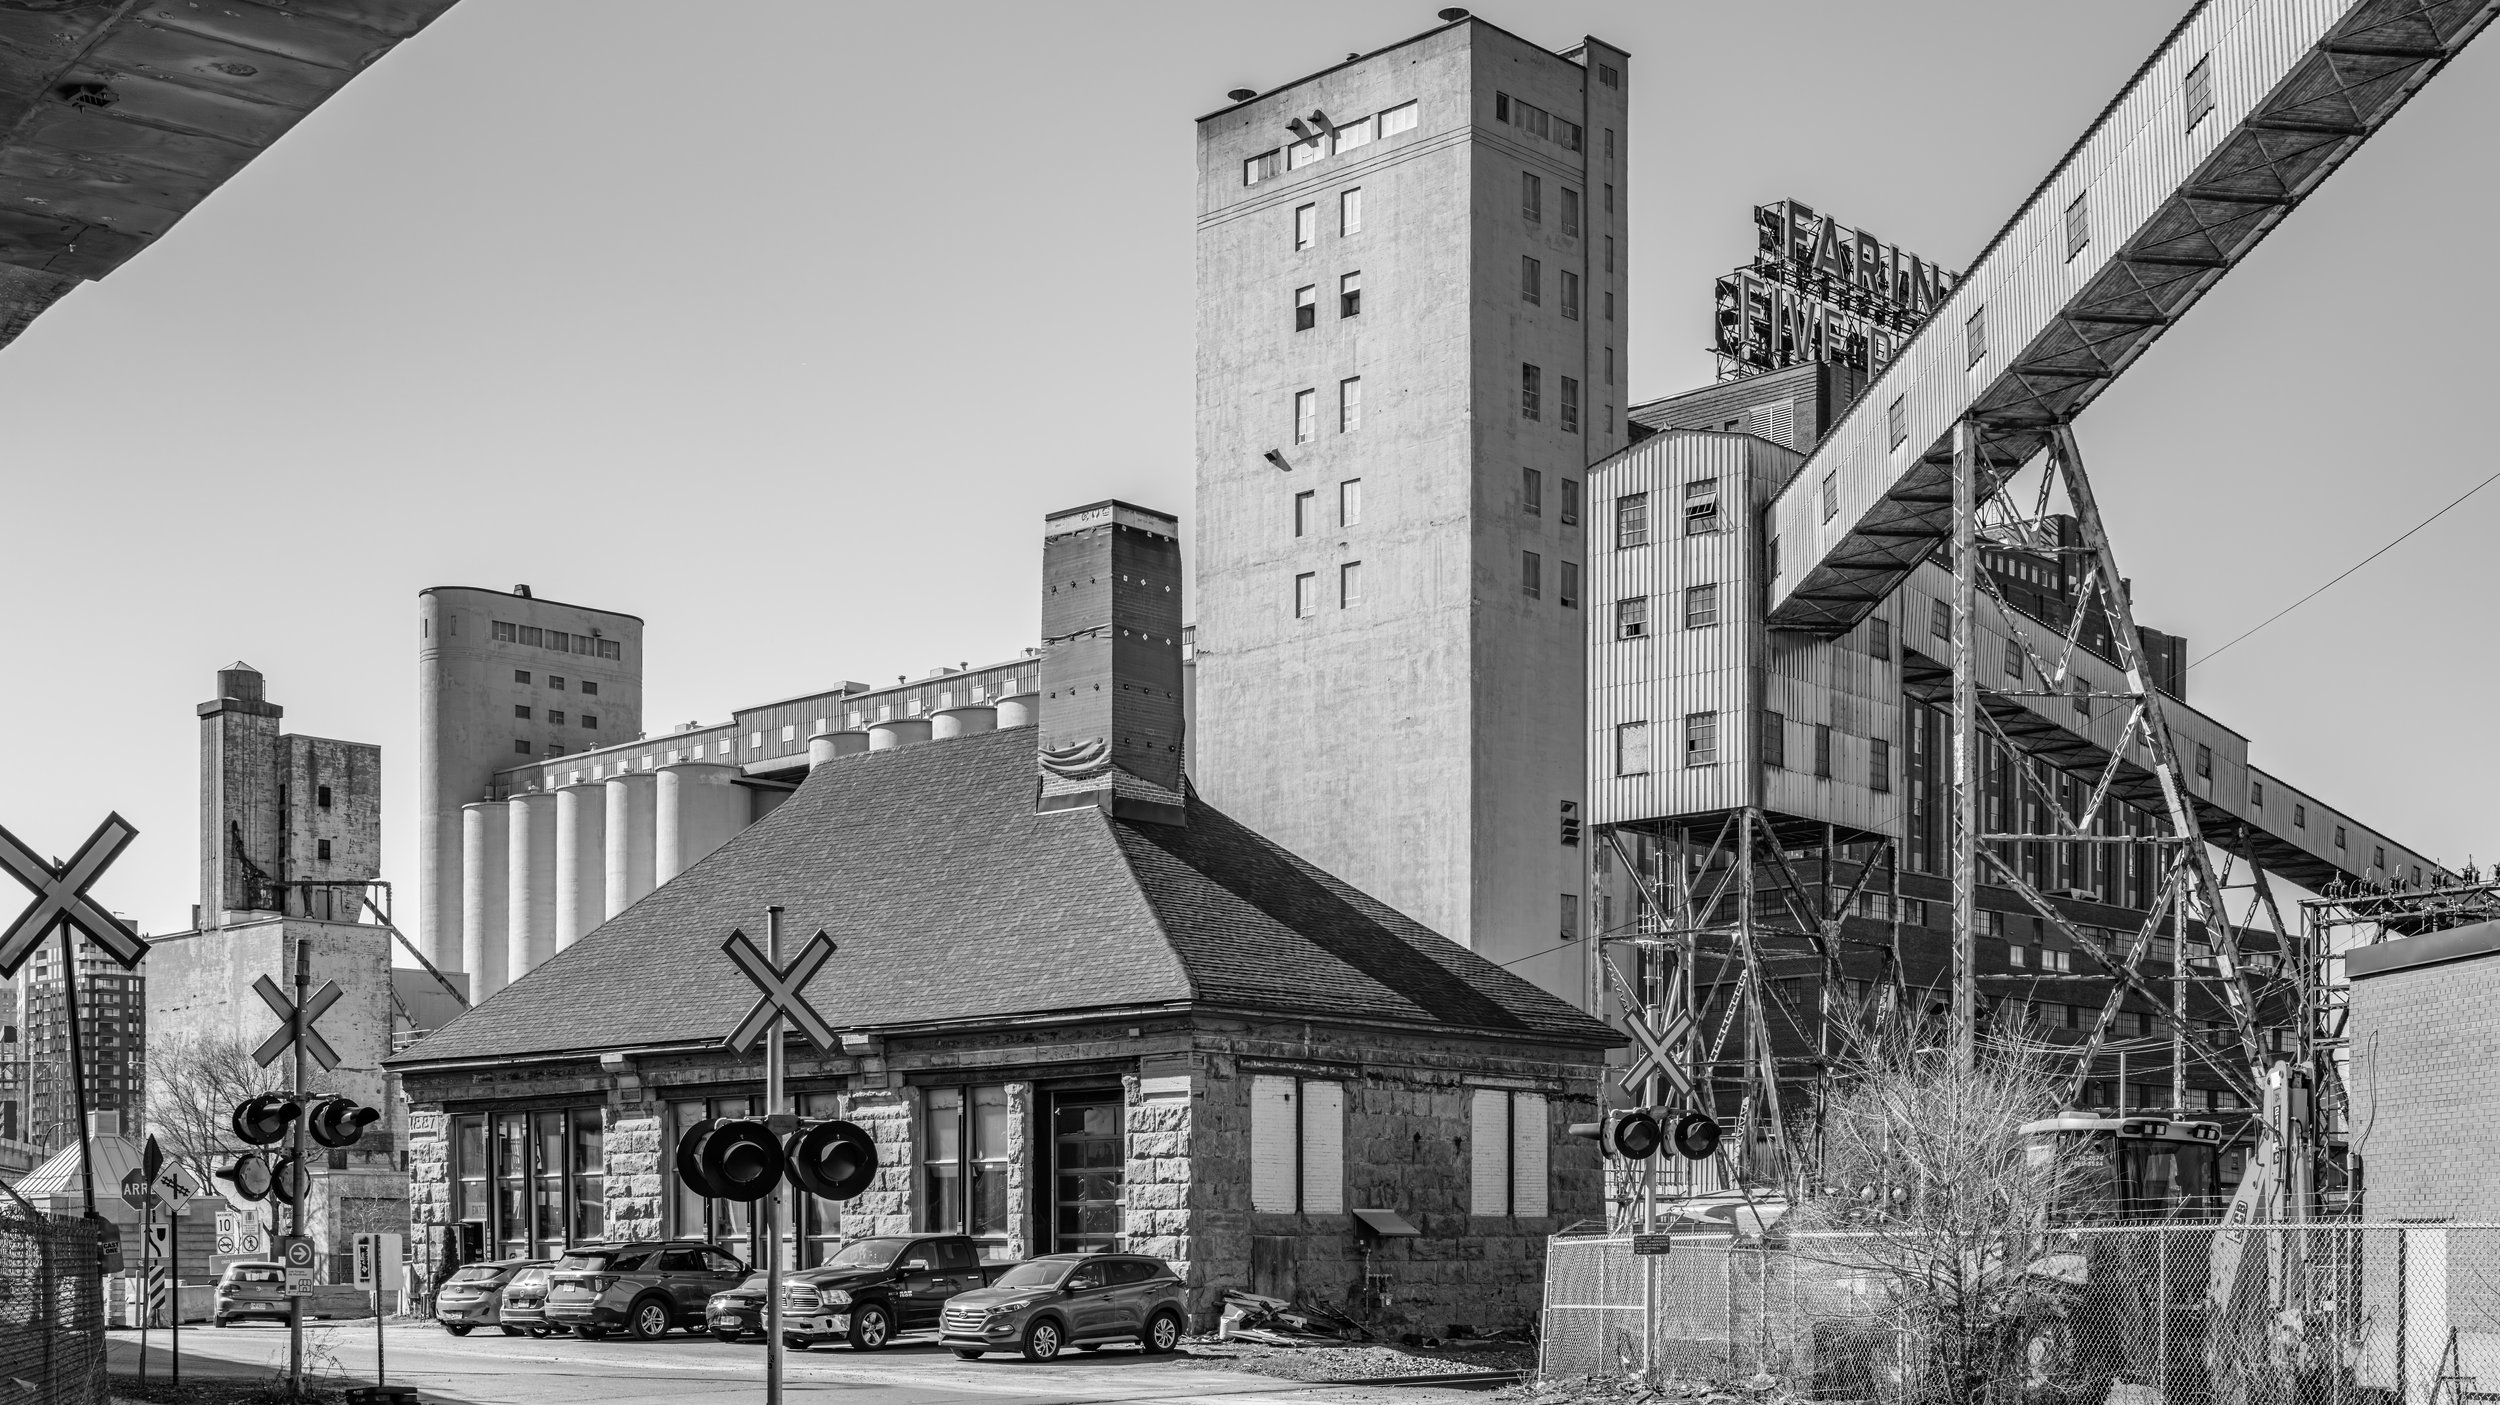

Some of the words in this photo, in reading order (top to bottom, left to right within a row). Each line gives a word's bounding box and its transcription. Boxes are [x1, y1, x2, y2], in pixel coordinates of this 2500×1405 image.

[1785, 197, 1961, 314] FARIN
[1740, 272, 1846, 361] FIVE
[410, 1115, 435, 1130] 1887
[123, 1183, 156, 1195] ARR
[472, 1205, 486, 1215] ENTR
[219, 1218, 231, 1232] 10
[103, 1241, 119, 1249] CAST
